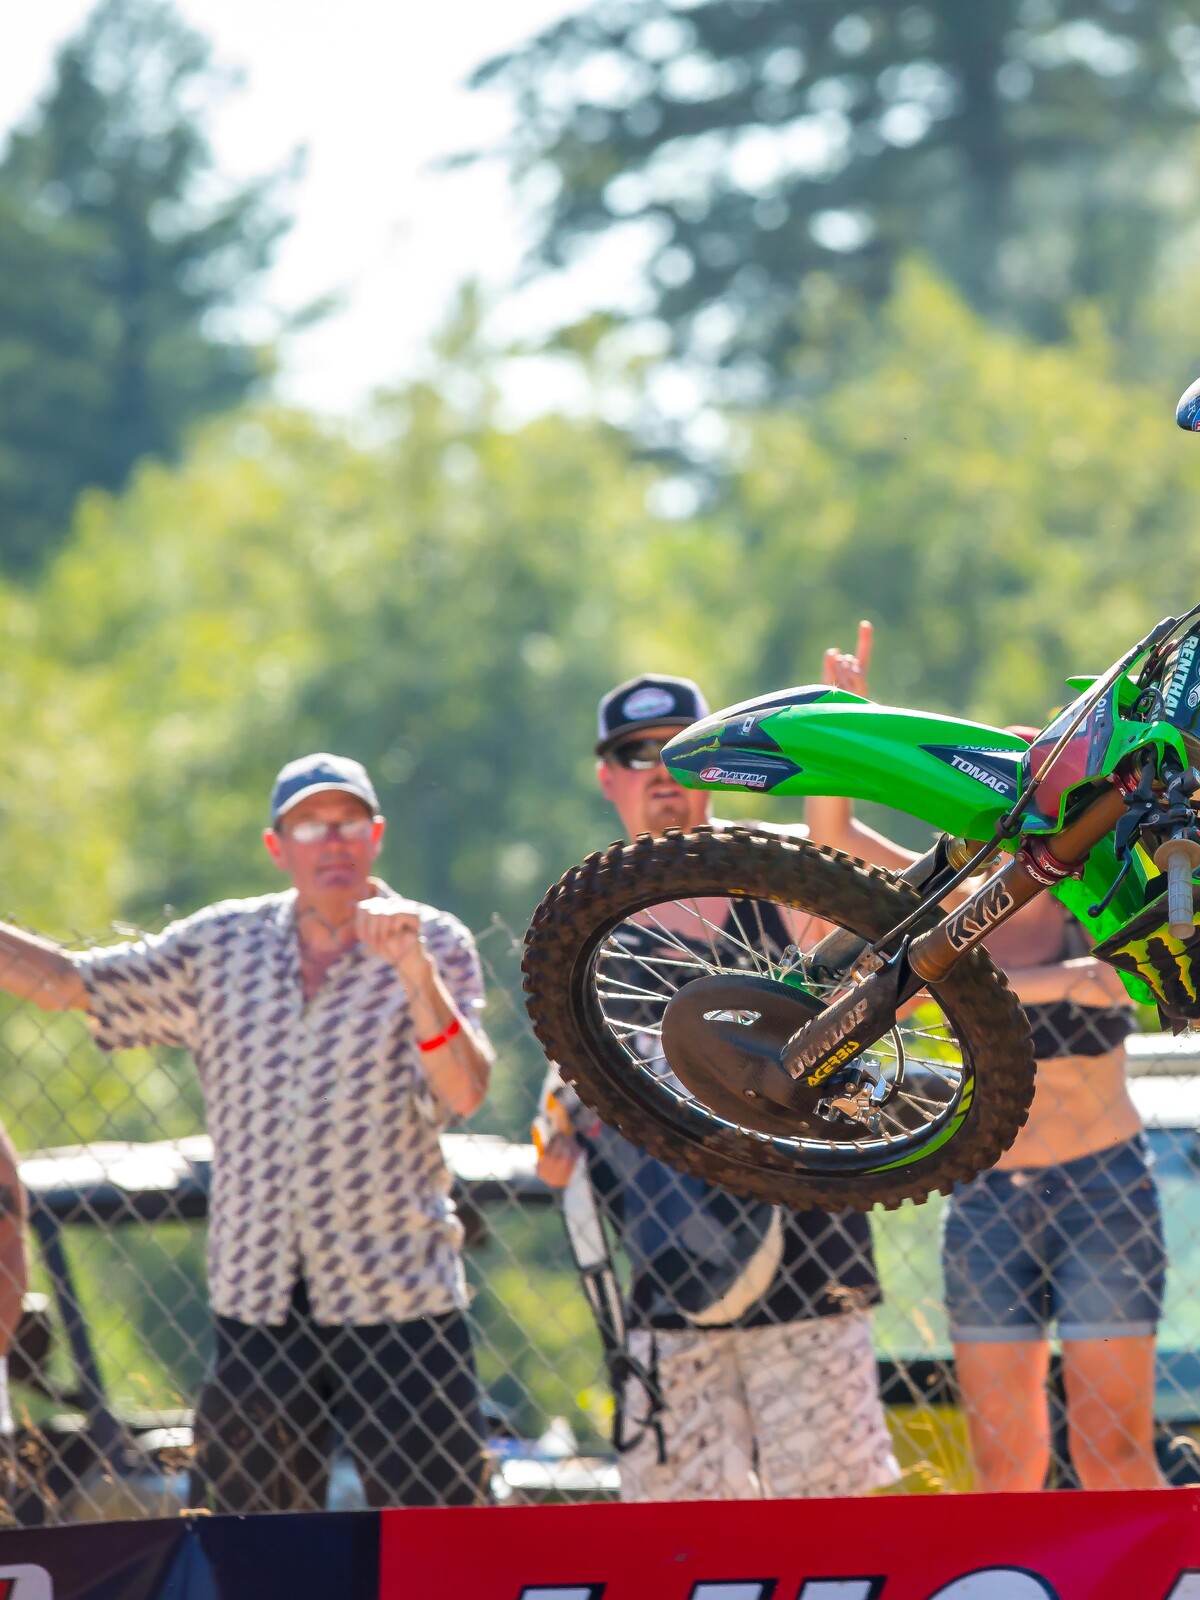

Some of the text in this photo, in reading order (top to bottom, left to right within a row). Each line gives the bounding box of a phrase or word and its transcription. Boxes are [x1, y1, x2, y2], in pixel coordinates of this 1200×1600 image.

[1095, 698, 1107, 723] OIL
[950, 754, 1010, 795] TOMAC
[807, 1040, 860, 1088] ACERBIS
